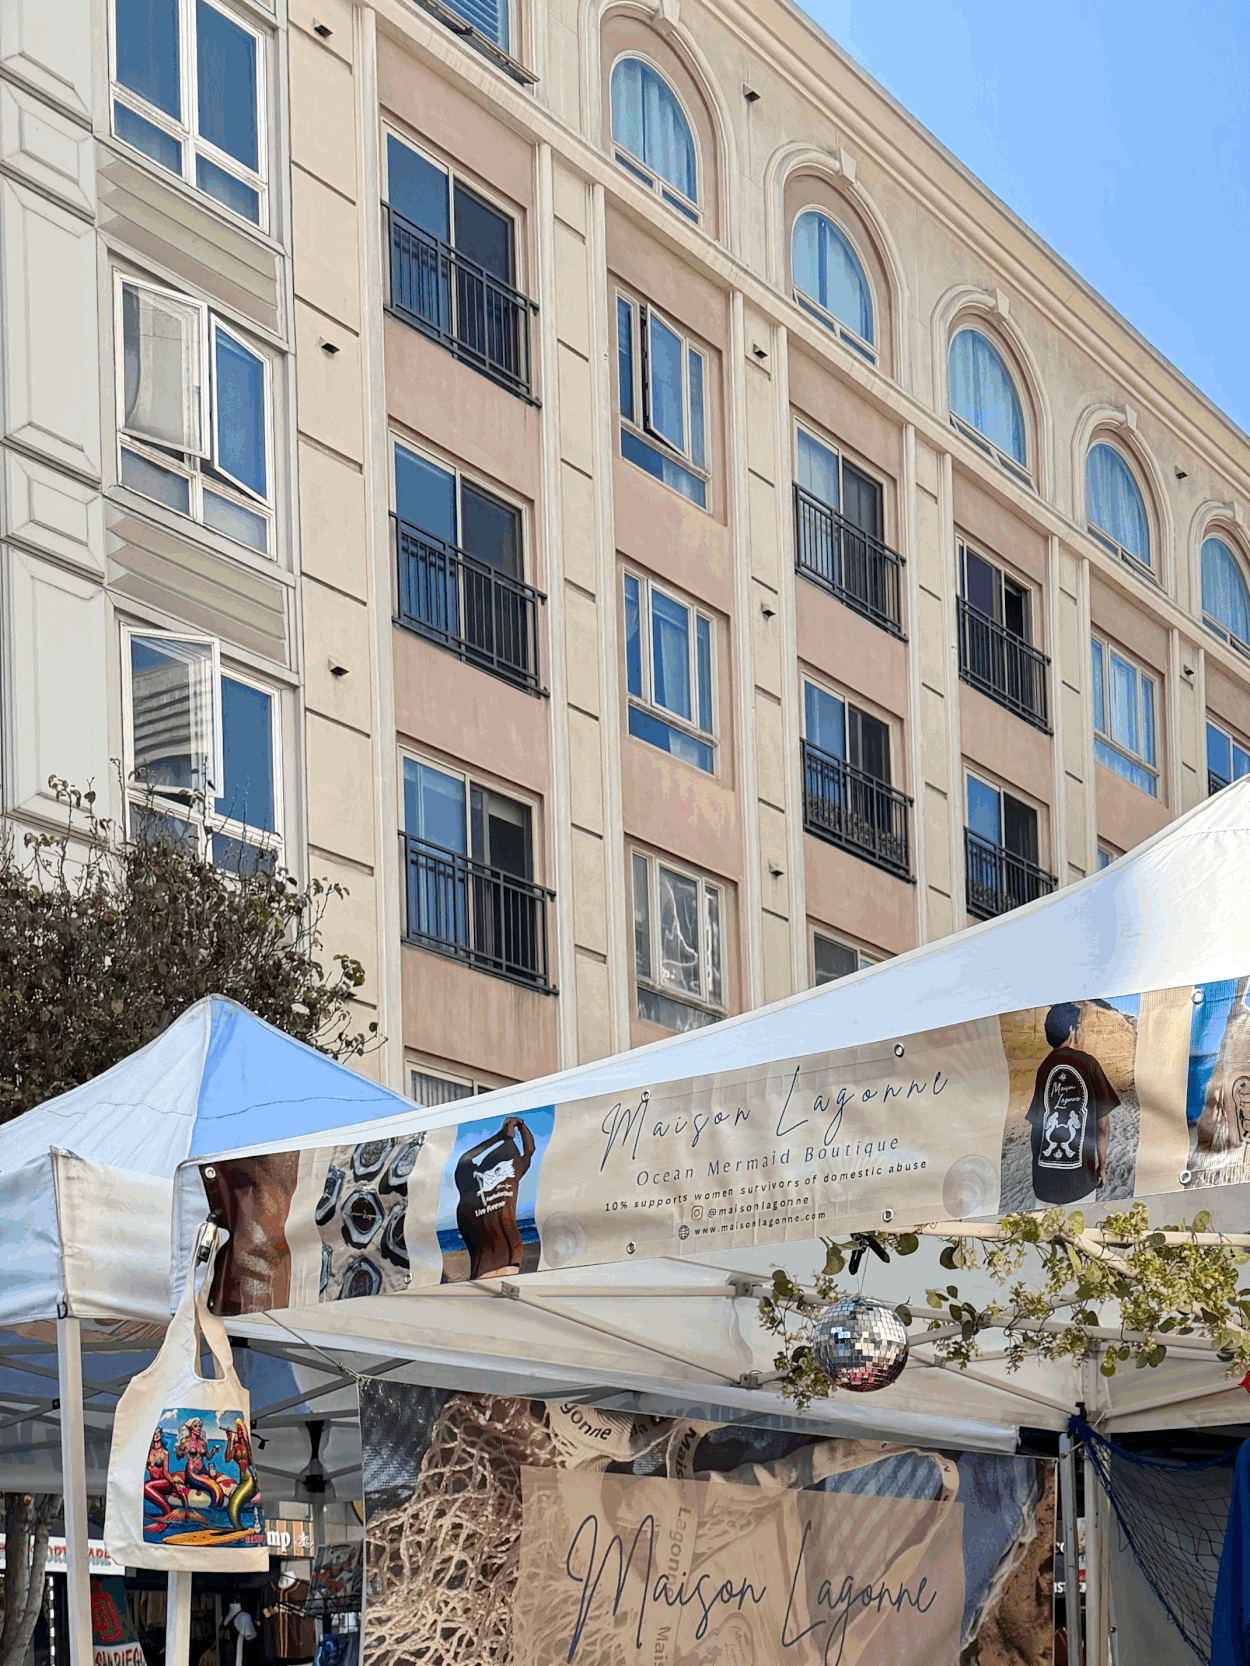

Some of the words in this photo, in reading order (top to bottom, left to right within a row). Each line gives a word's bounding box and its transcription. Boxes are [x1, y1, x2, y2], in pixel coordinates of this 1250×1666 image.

[600, 1094, 750, 1172] Maison
[776, 1064, 948, 1146] Lagonne
[605, 1199, 628, 1212] 10%
[634, 1193, 688, 1209] supports
[694, 1187, 733, 1201] women
[740, 1179, 799, 1196] survivors
[804, 1174, 818, 1186] of
[823, 1166, 882, 1184] domestic
[888, 1160, 927, 1174] abuse
[637, 1168, 694, 1187] Ocean
[707, 1148, 790, 1177] Mermaid
[804, 1137, 900, 1163] Boutique
[694, 1211, 826, 1236] www.maisonlagonne.com
[707, 1196, 809, 1218] @maisonlagonne
[560, 1403, 612, 1441] gonne
[566, 1514, 767, 1663] Maison
